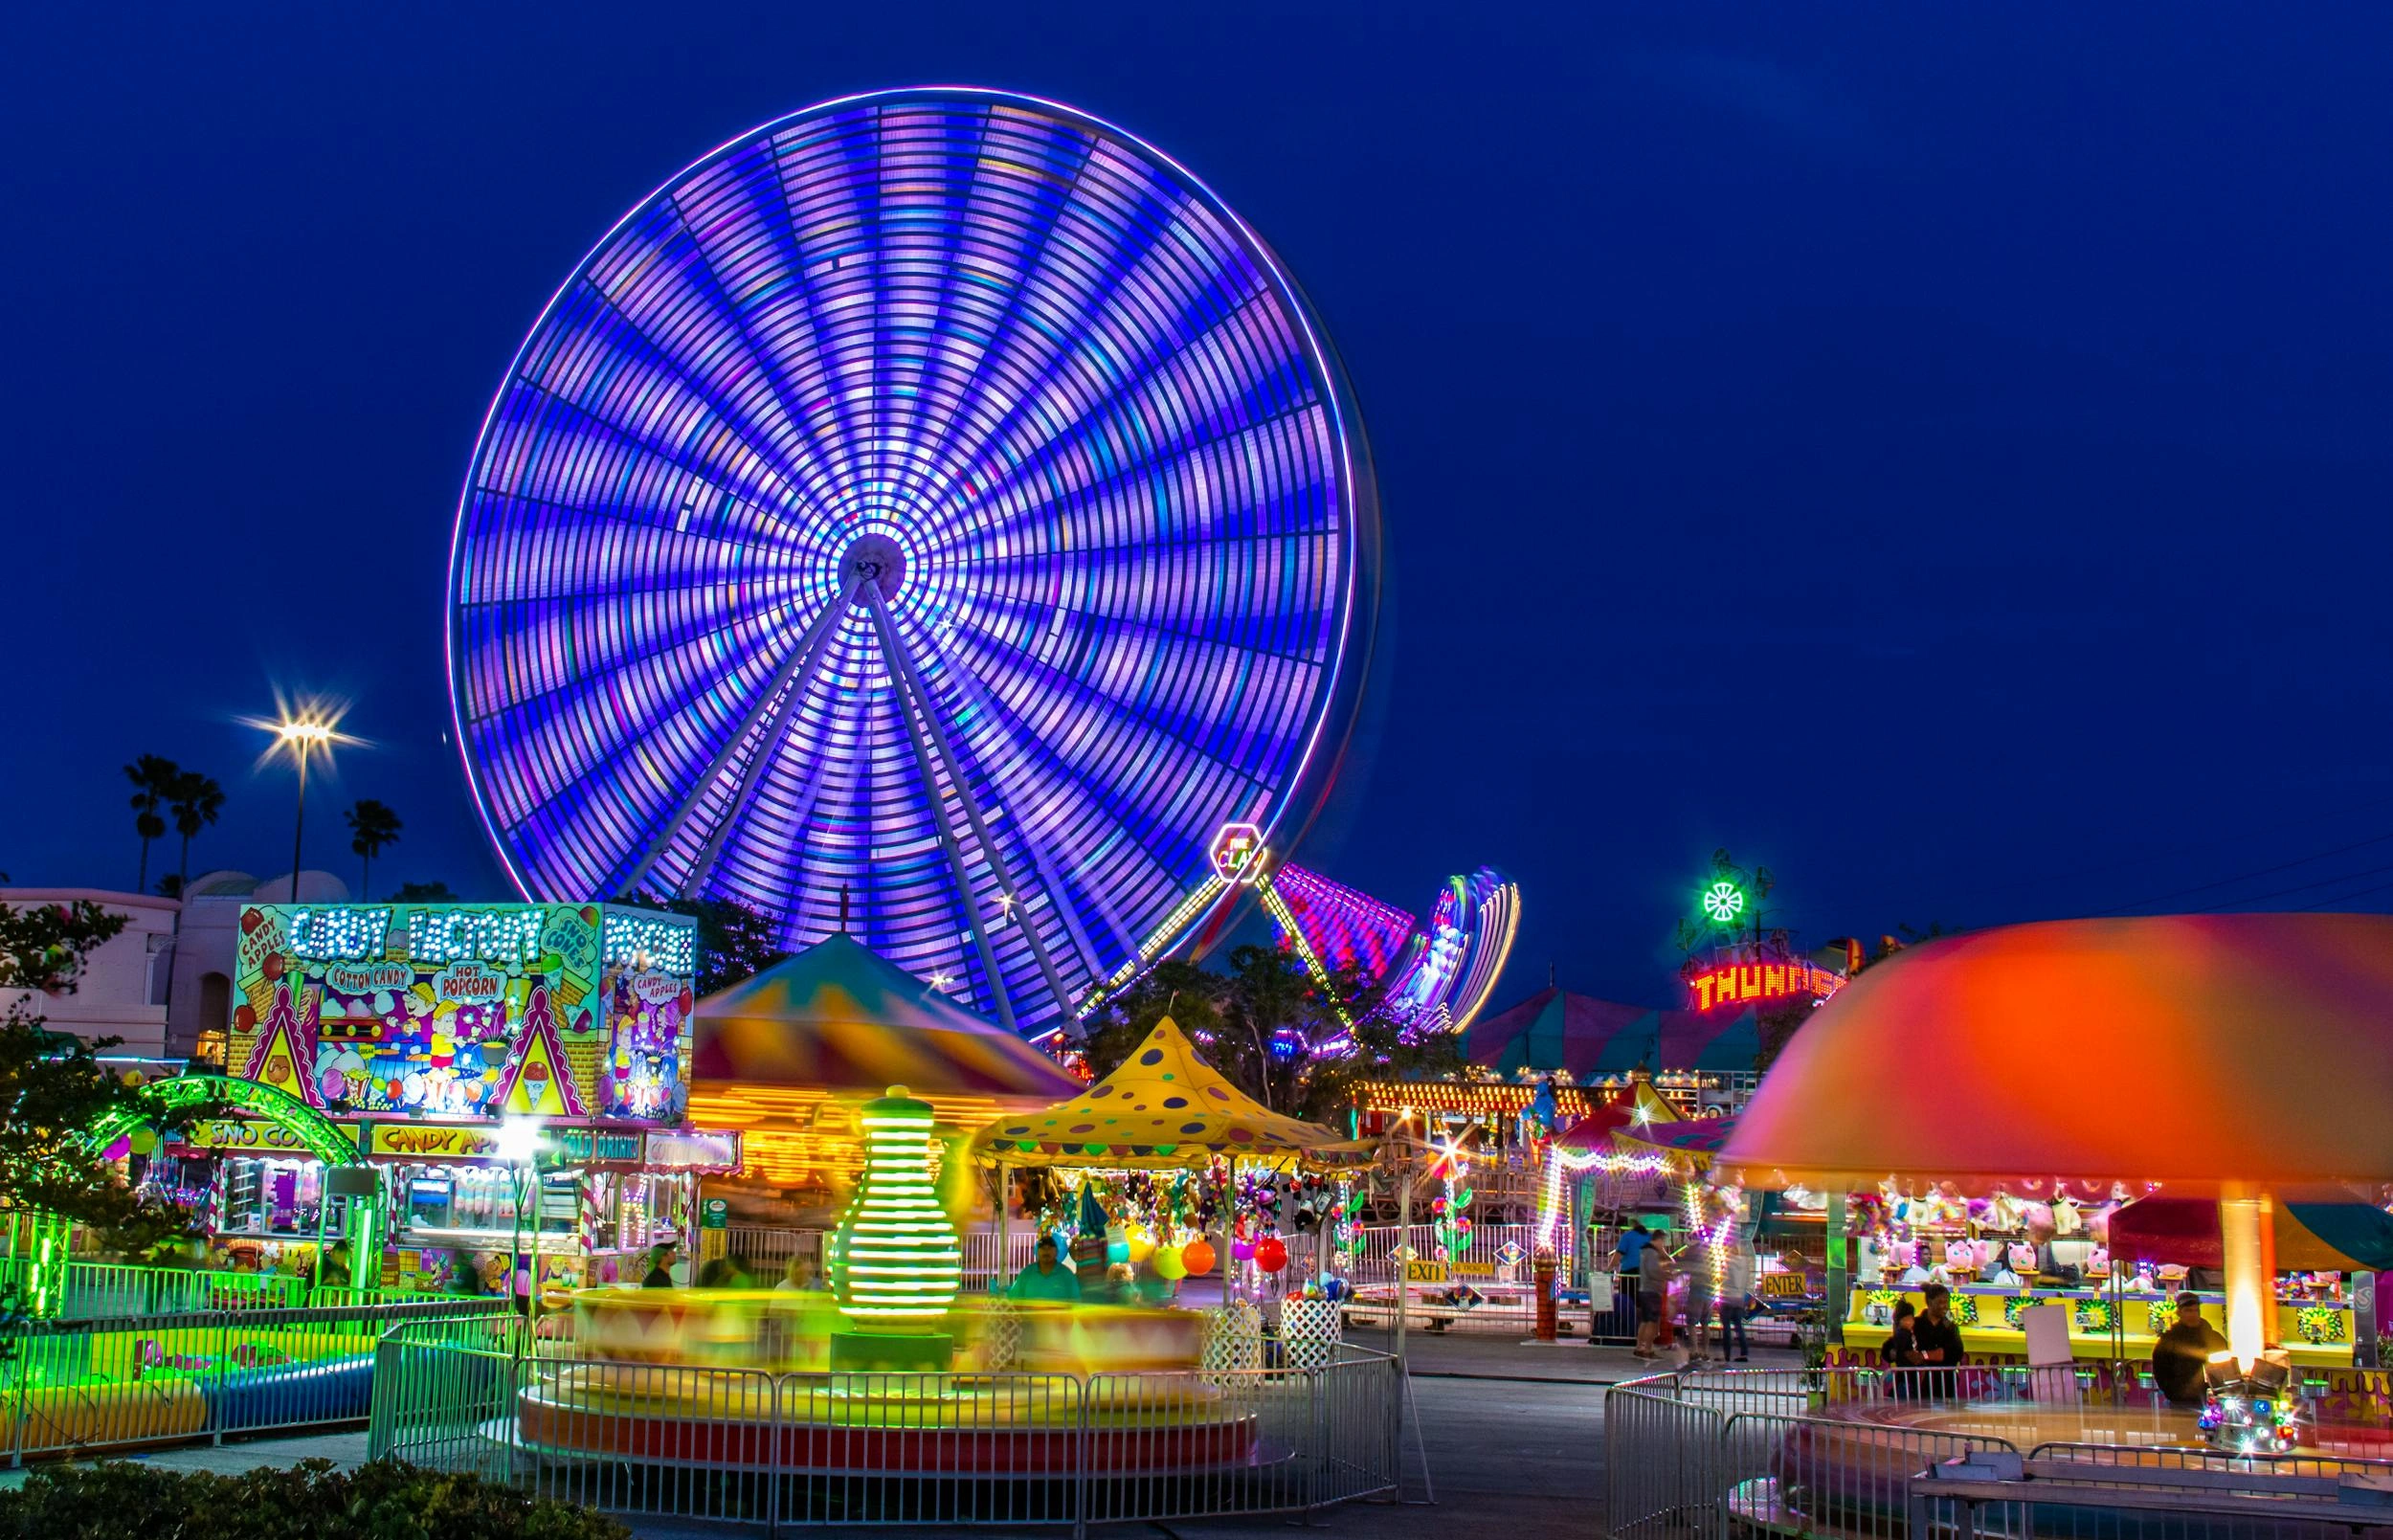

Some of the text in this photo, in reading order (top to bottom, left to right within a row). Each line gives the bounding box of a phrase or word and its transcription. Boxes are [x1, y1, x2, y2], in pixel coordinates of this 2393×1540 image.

[242, 917, 276, 956] CANDY
[290, 905, 546, 963] CANDY FACTORY
[560, 919, 587, 948] SNO
[248, 929, 286, 970] APPLES
[546, 930, 585, 969] CONES
[334, 968, 407, 989] COTTON CANDY
[455, 966, 481, 977] HOT
[637, 975, 663, 989] CANDY
[442, 977, 499, 996] POPCORN
[649, 984, 678, 997] APPLES
[211, 1124, 257, 1146] SNO
[262, 1124, 306, 1149] CO
[382, 1127, 458, 1154] CANDY
[597, 1133, 638, 1160] DRINKS
[1407, 1262, 1440, 1281] EXIT
[1765, 1275, 1804, 1293] ENTER
